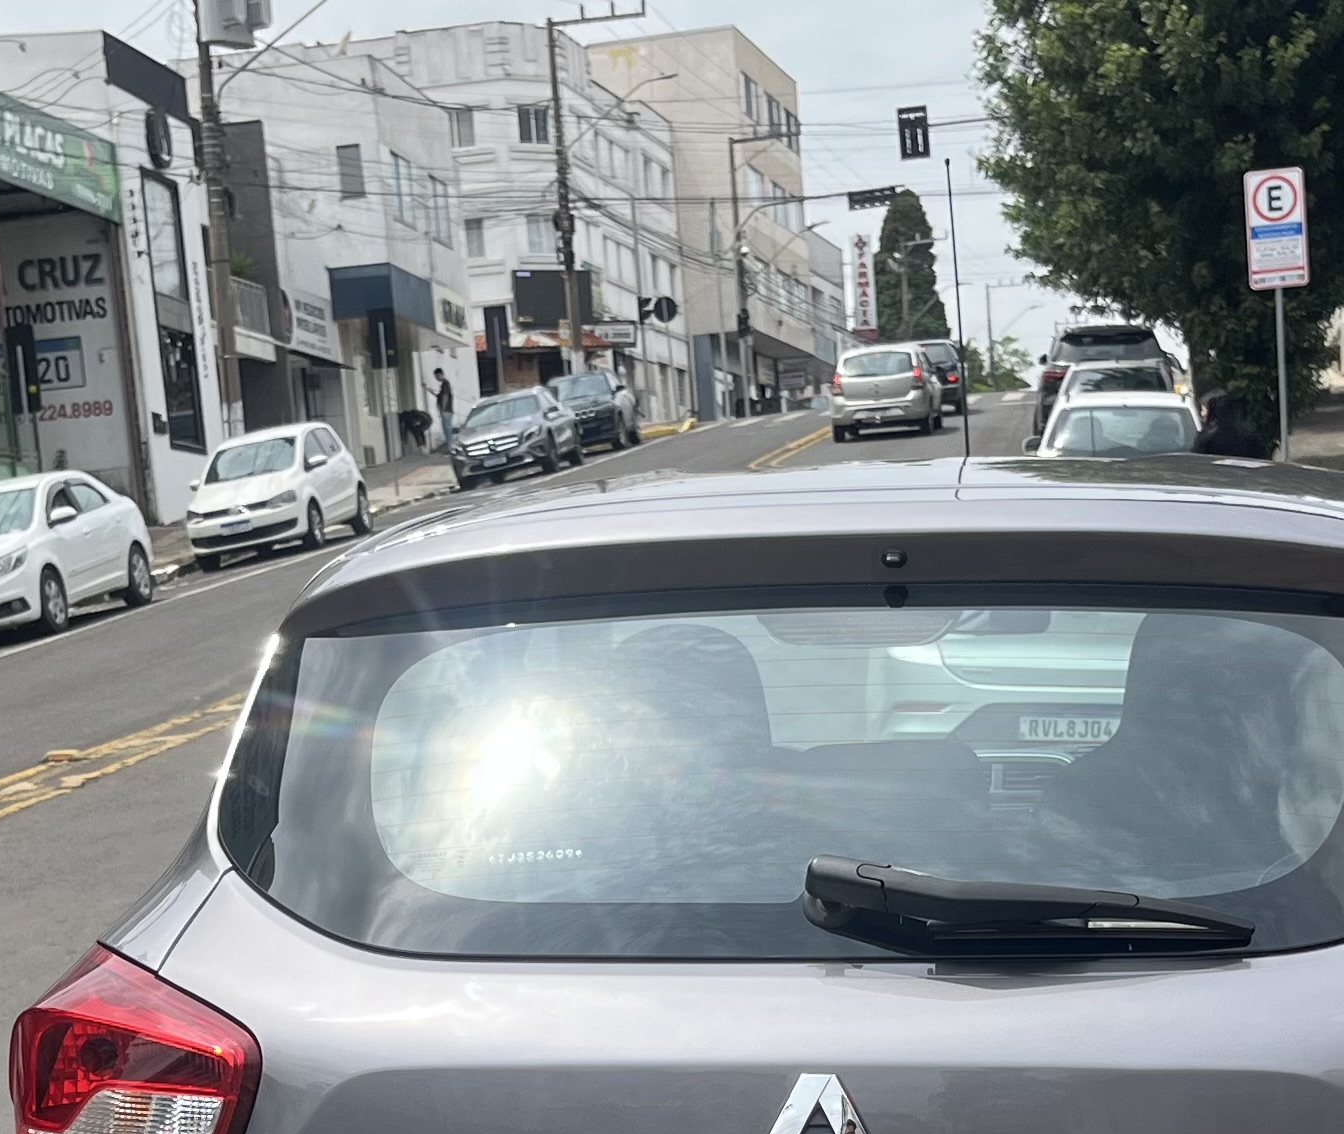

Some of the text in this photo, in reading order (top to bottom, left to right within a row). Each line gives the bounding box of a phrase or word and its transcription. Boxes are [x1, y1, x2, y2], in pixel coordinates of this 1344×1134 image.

[3, 111, 65, 169] PLACAS
[1267, 185, 1283, 211] E
[17, 253, 104, 292] CRUZ
[1028, 719, 1113, 738] RVL8J04
